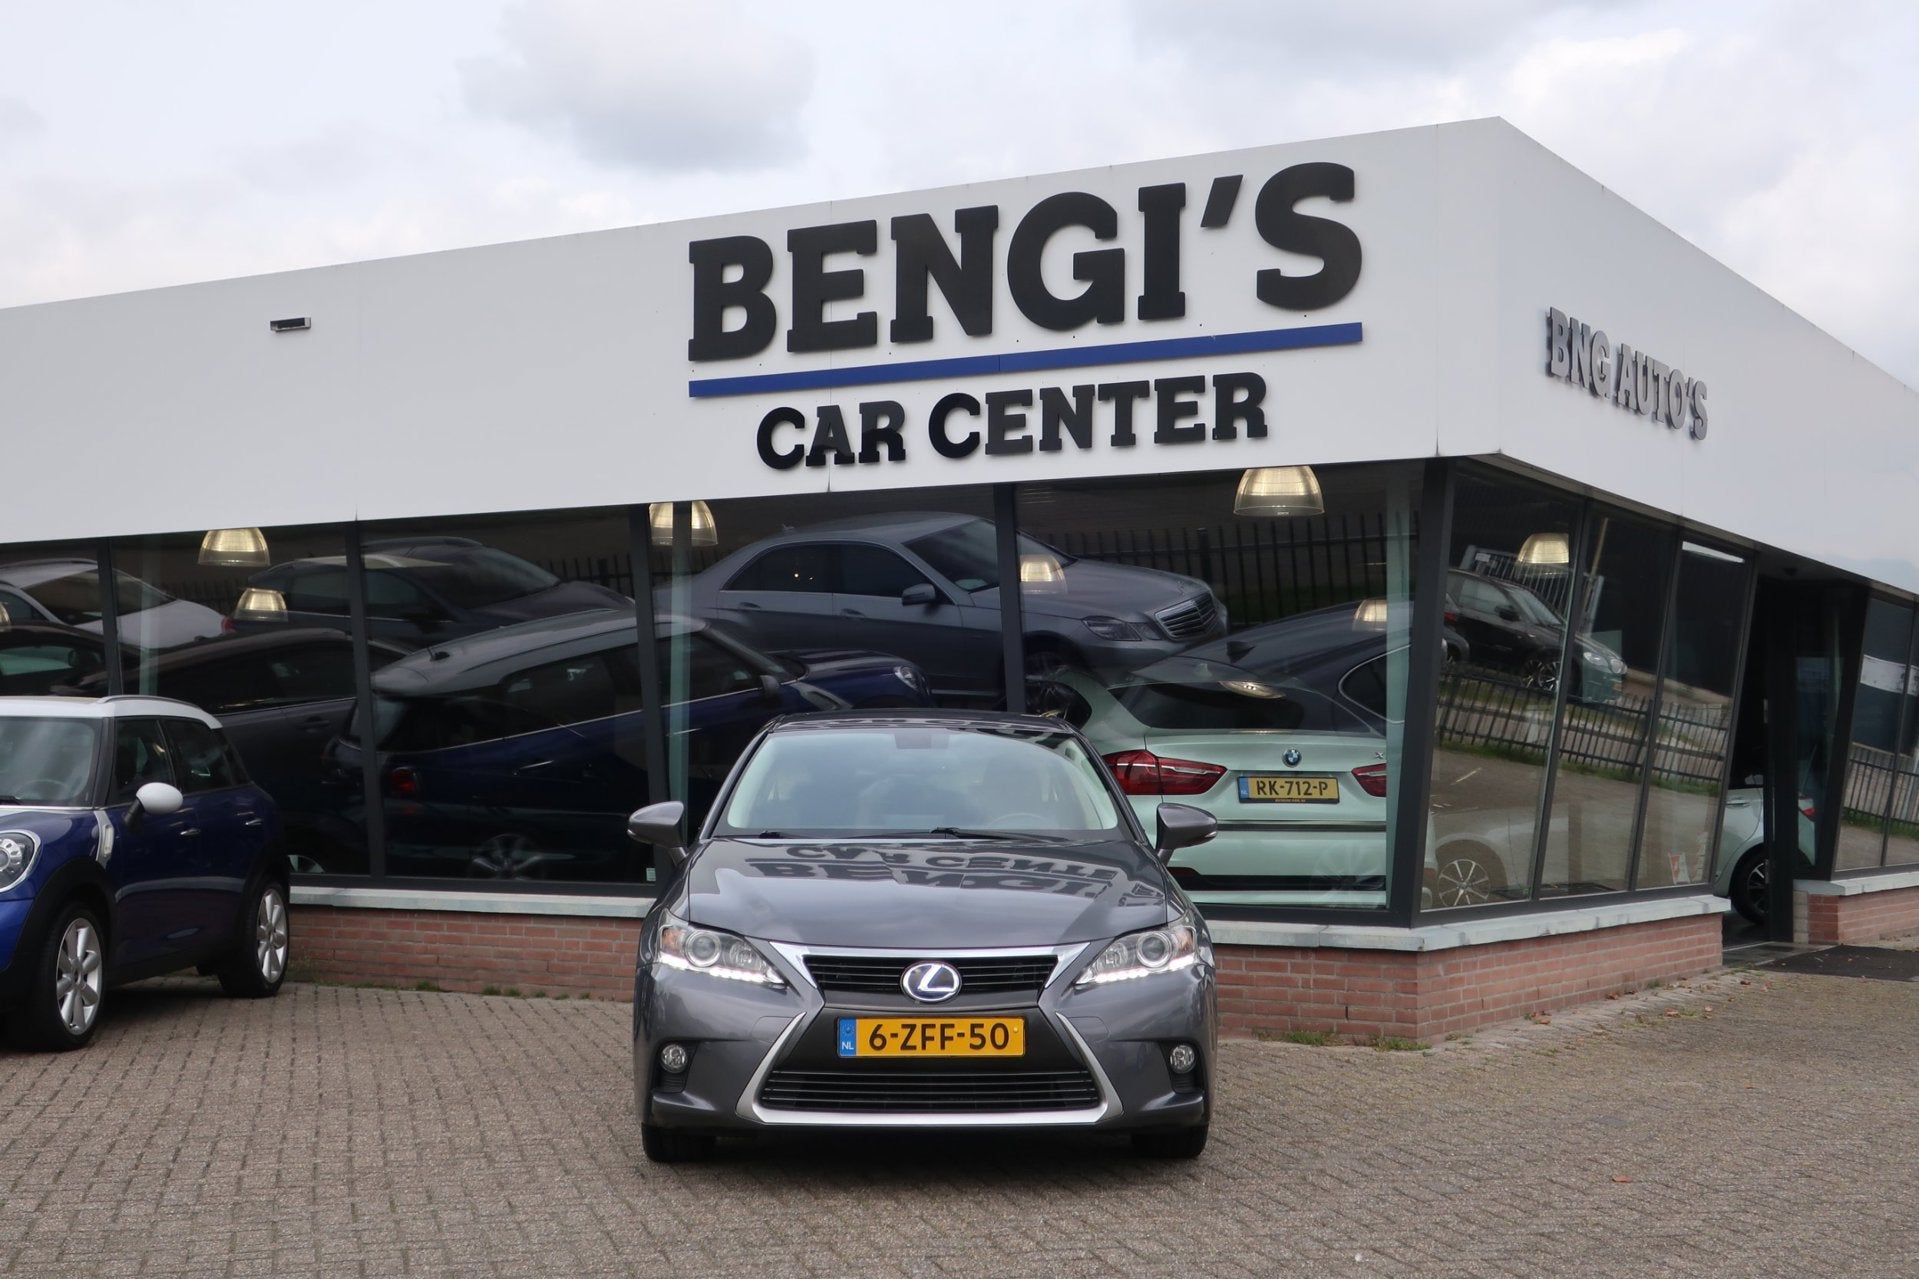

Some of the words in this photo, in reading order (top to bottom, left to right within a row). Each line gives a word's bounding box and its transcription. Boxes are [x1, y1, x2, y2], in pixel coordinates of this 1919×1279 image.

[688, 161, 1362, 362] BENGI'S
[1546, 306, 1611, 399] BNG
[1616, 343, 1708, 440] AUTO'S
[756, 400, 906, 470] CAR
[929, 372, 1268, 459] CENTER
[1256, 780, 1328, 796] RK-712-P
[841, 1041, 855, 1050] NL
[869, 1022, 1010, 1051] 6-ZFF-50
